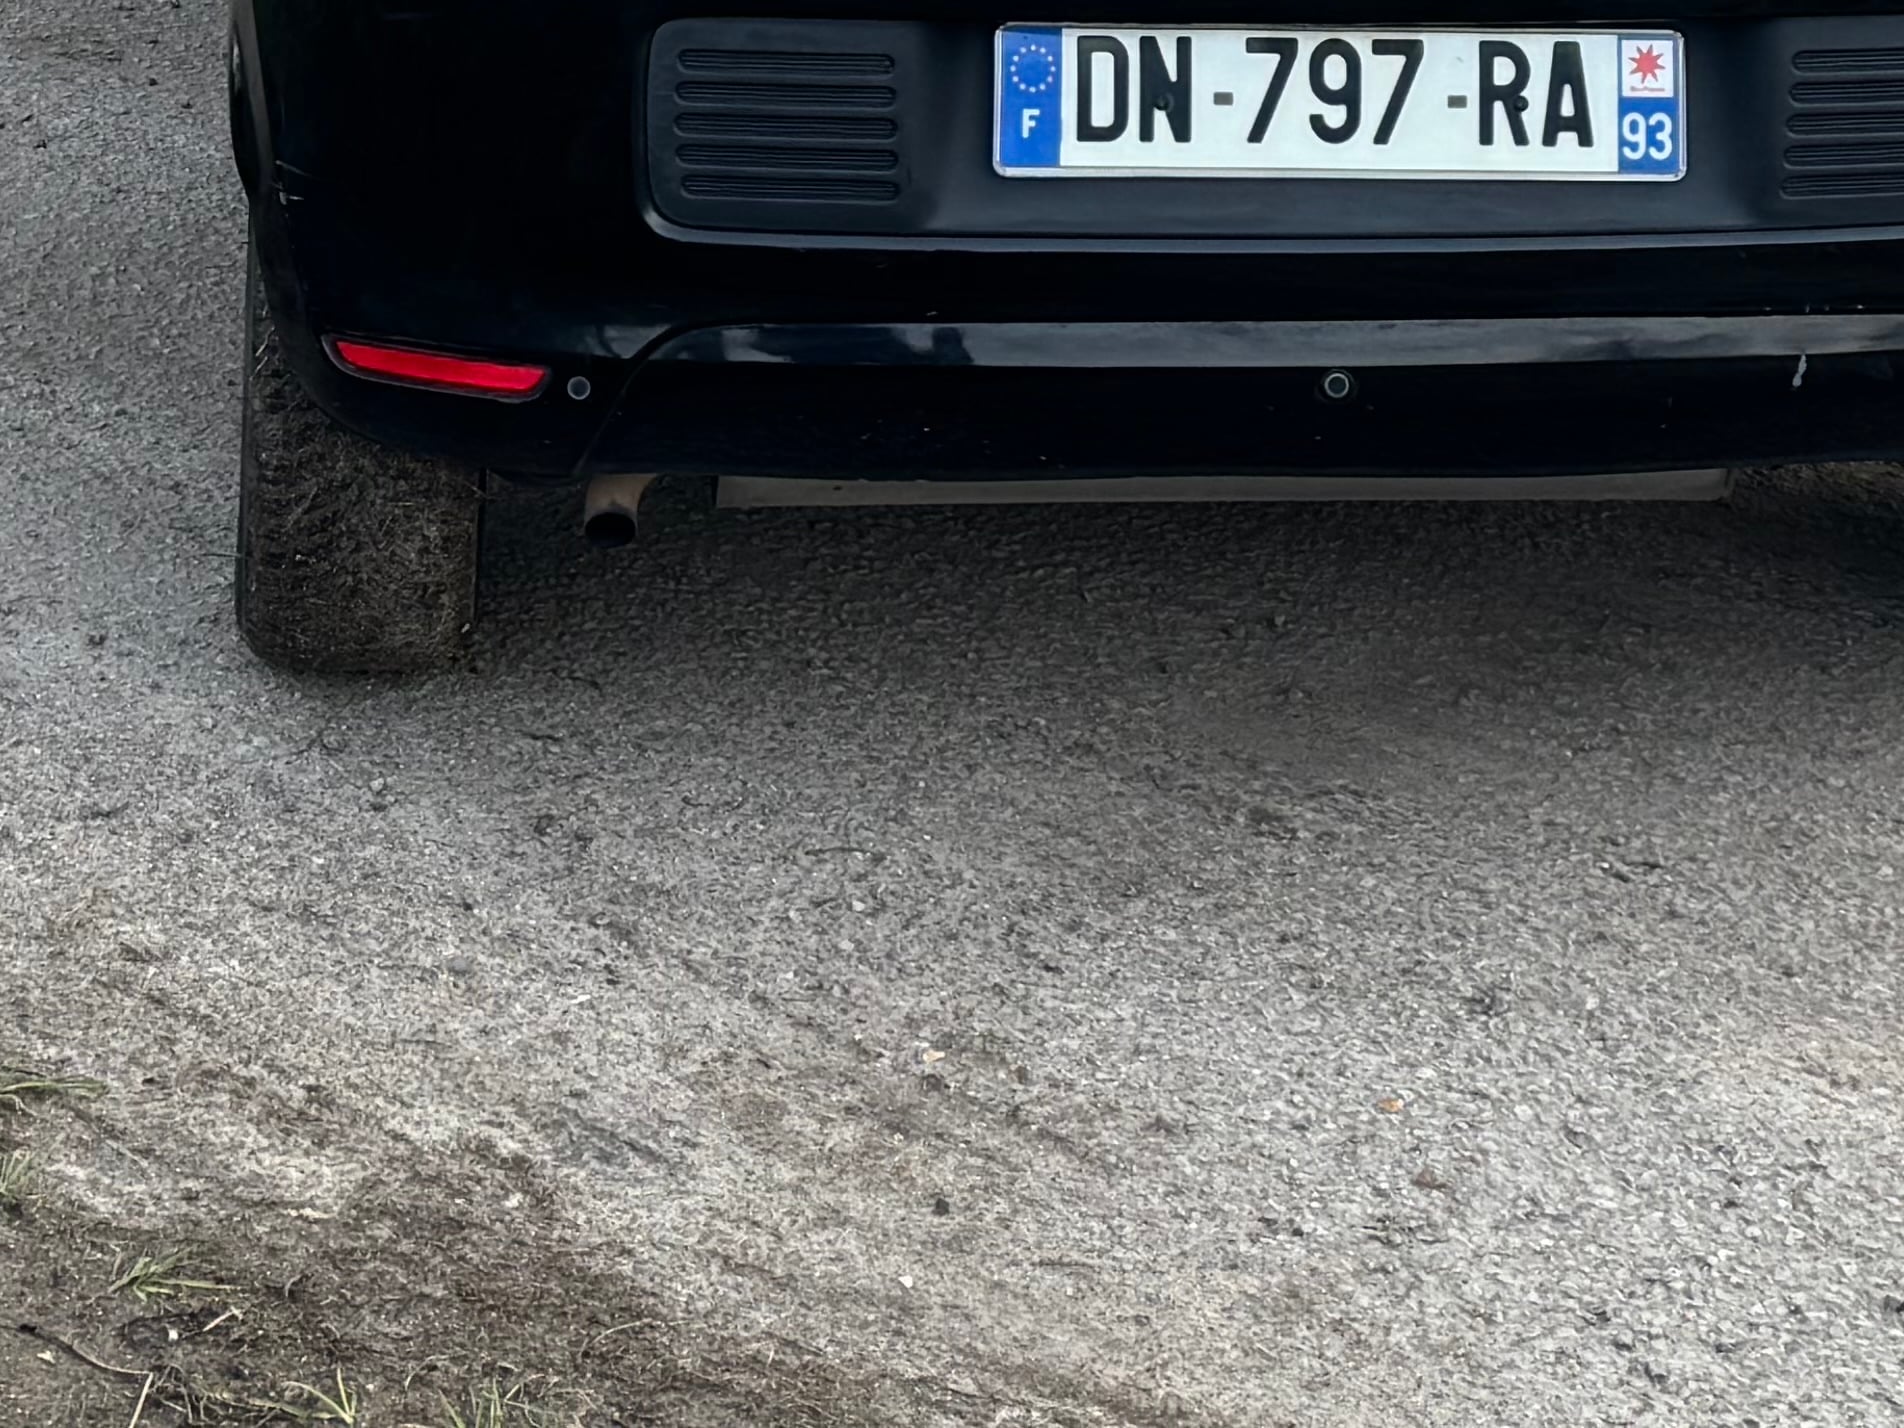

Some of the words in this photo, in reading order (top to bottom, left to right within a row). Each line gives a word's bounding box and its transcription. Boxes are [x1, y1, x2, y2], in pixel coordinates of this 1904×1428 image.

[1075, 35, 1594, 148] DN-797-RA
[1021, 108, 1040, 138] F
[1622, 111, 1673, 160] 93
